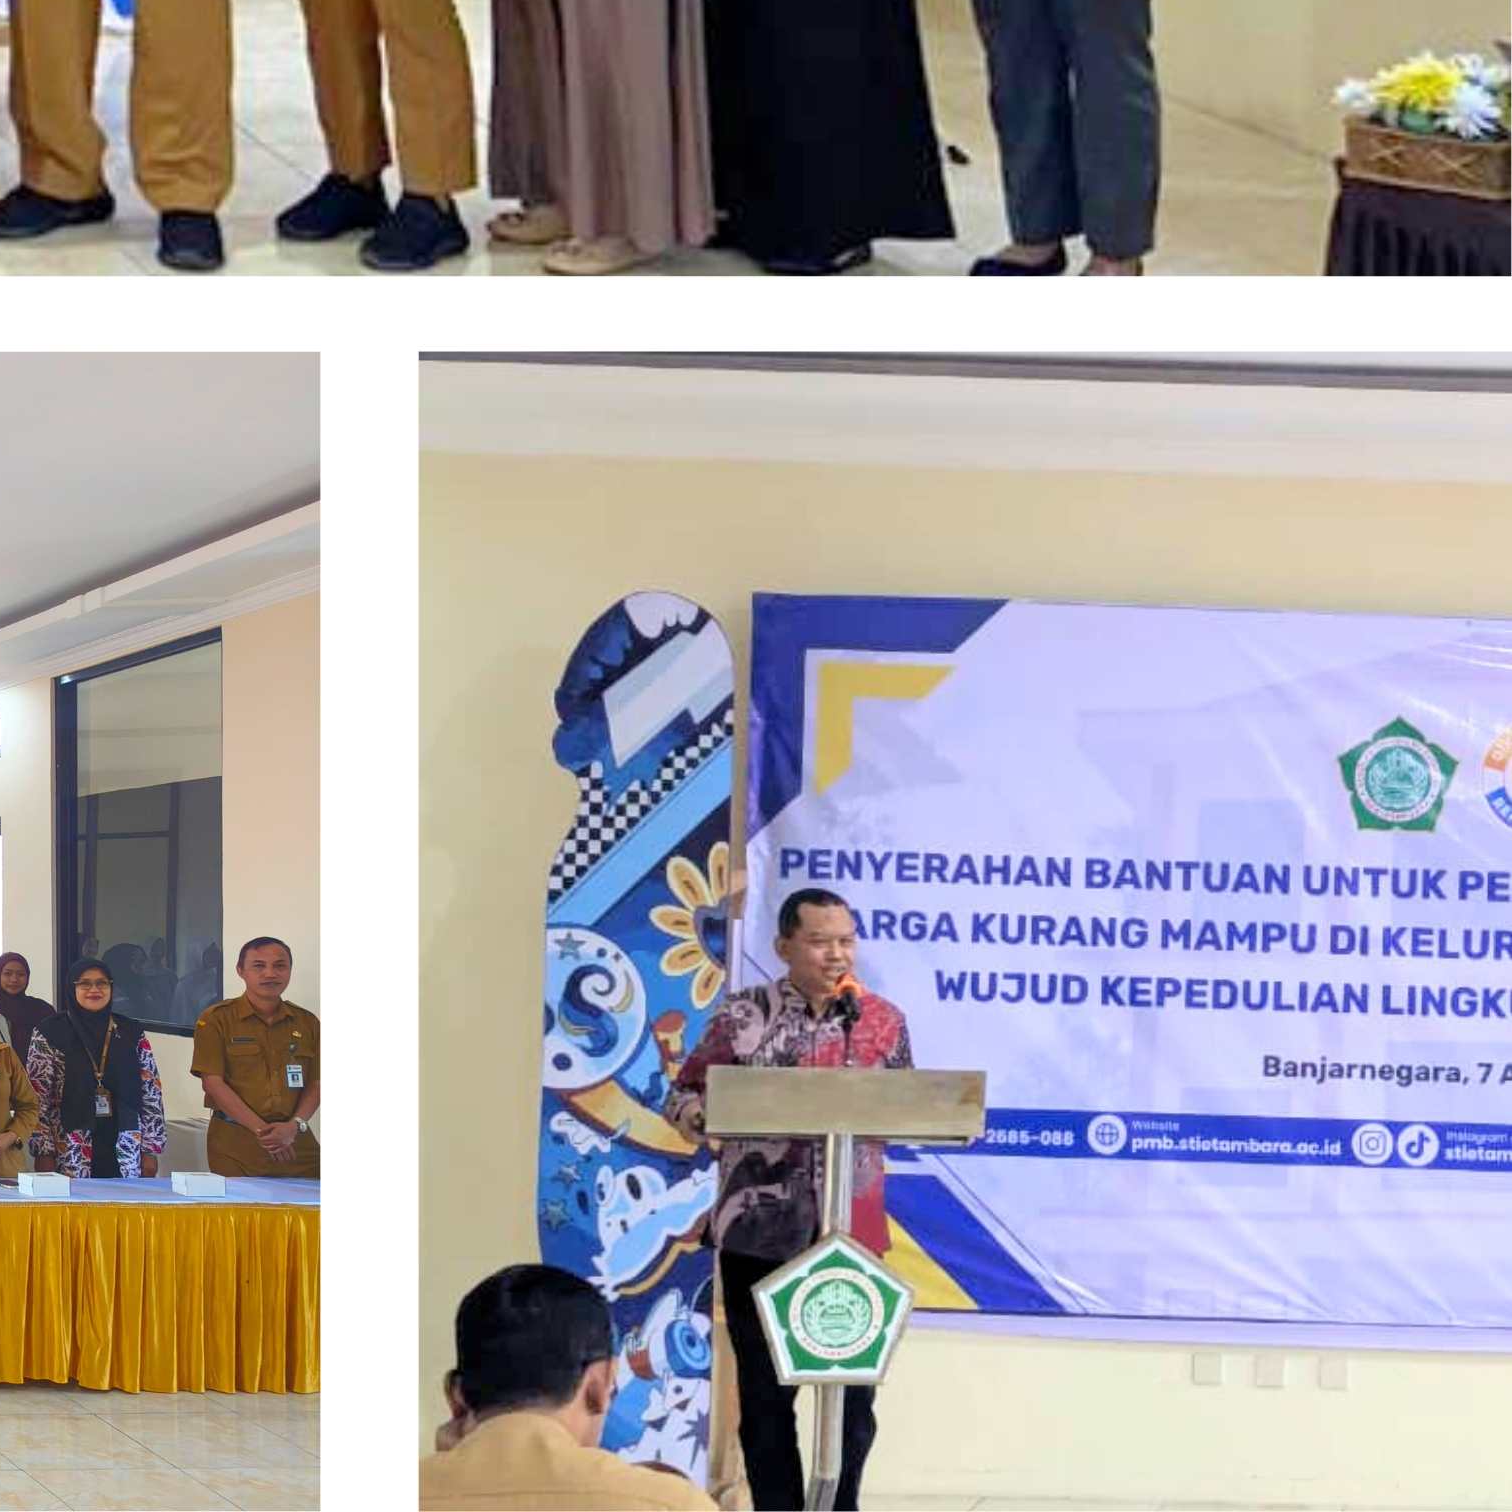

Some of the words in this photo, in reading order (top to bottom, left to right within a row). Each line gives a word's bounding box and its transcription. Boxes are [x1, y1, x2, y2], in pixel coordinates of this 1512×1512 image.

[780, 846, 1072, 888] PENYERAHAN
[1085, 857, 1291, 897] BANTUAN
[1303, 865, 1445, 902] UNTUK
[851, 909, 959, 944] ARGA
[971, 912, 1148, 950] KURANG
[1160, 919, 1317, 955] MAMPU
[1329, 925, 1370, 958] DI
[935, 968, 1090, 1005] WUJUD
[1100, 973, 1369, 1015] KEPEDULIAN
[1263, 1054, 1471, 1087] Banjarnegara,
[1477, 1062, 1494, 1085] 7
